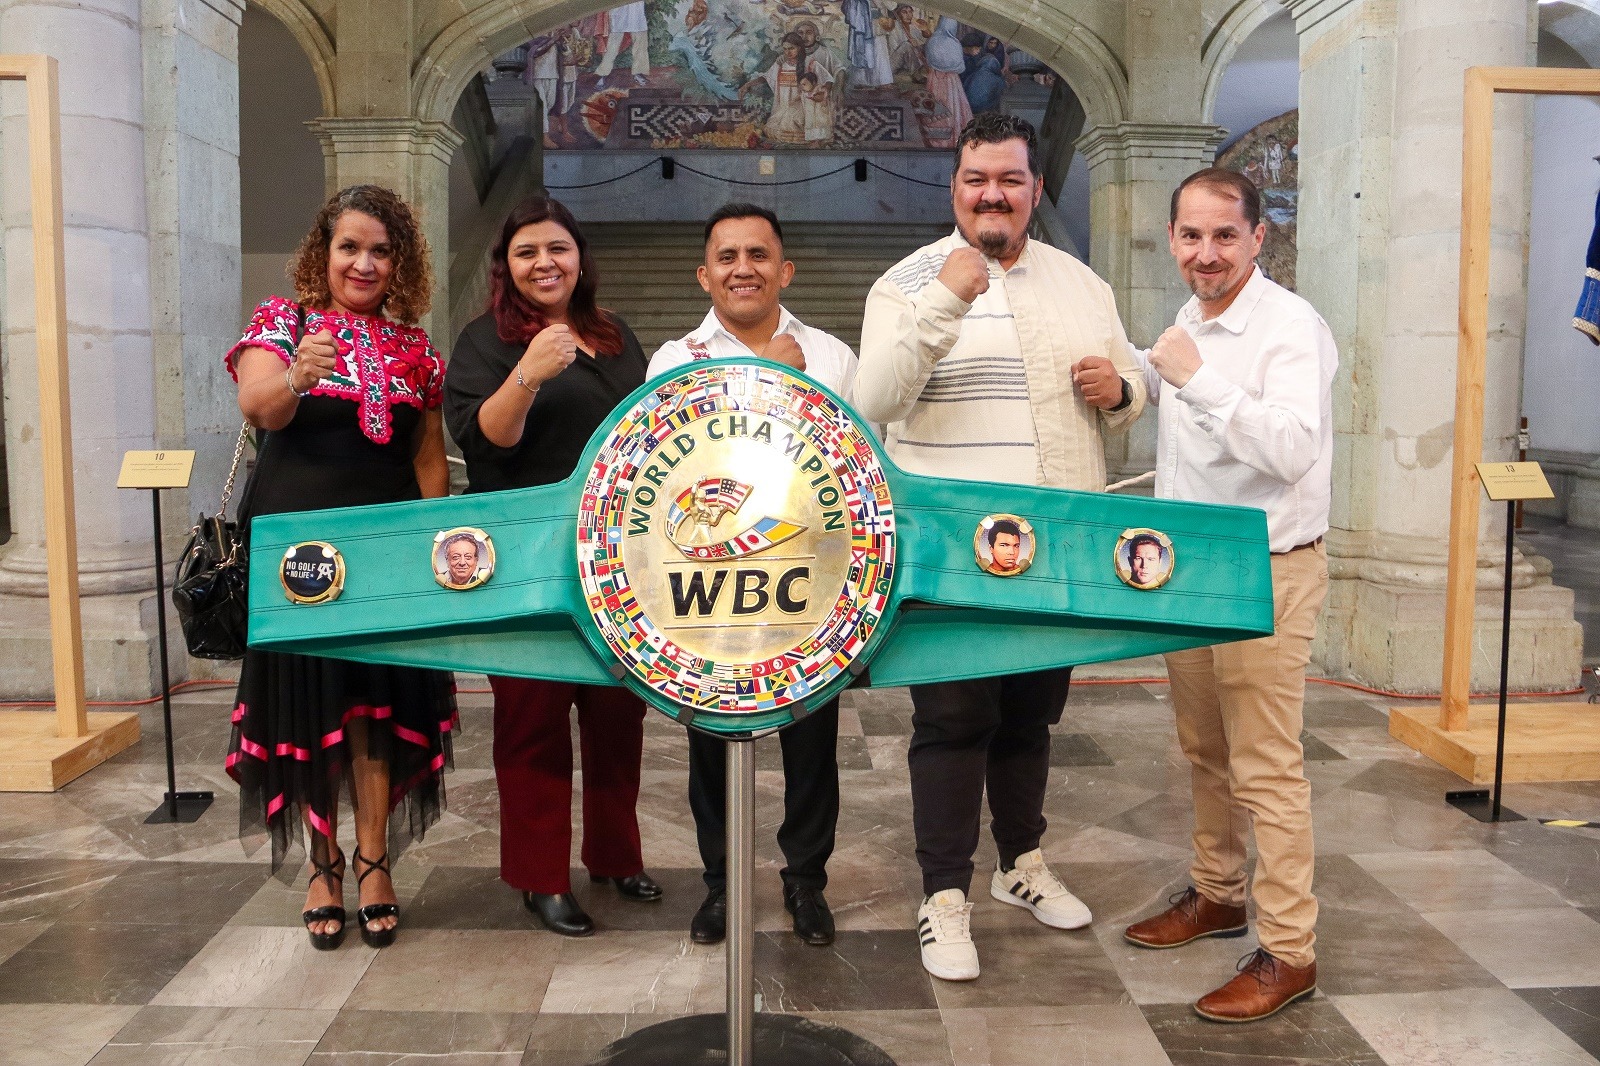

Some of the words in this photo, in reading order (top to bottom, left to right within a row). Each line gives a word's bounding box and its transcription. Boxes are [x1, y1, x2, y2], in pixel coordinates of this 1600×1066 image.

[155, 453, 164, 461] 10
[1505, 464, 1515, 473] 13
[628, 432, 696, 537] WORLD
[706, 415, 847, 533] CHAMPION
[286, 561, 296, 570] NO
[298, 562, 316, 572] GOLF
[290, 570, 298, 578] NO
[298, 571, 310, 579] LIFE
[667, 566, 811, 619] WBC
